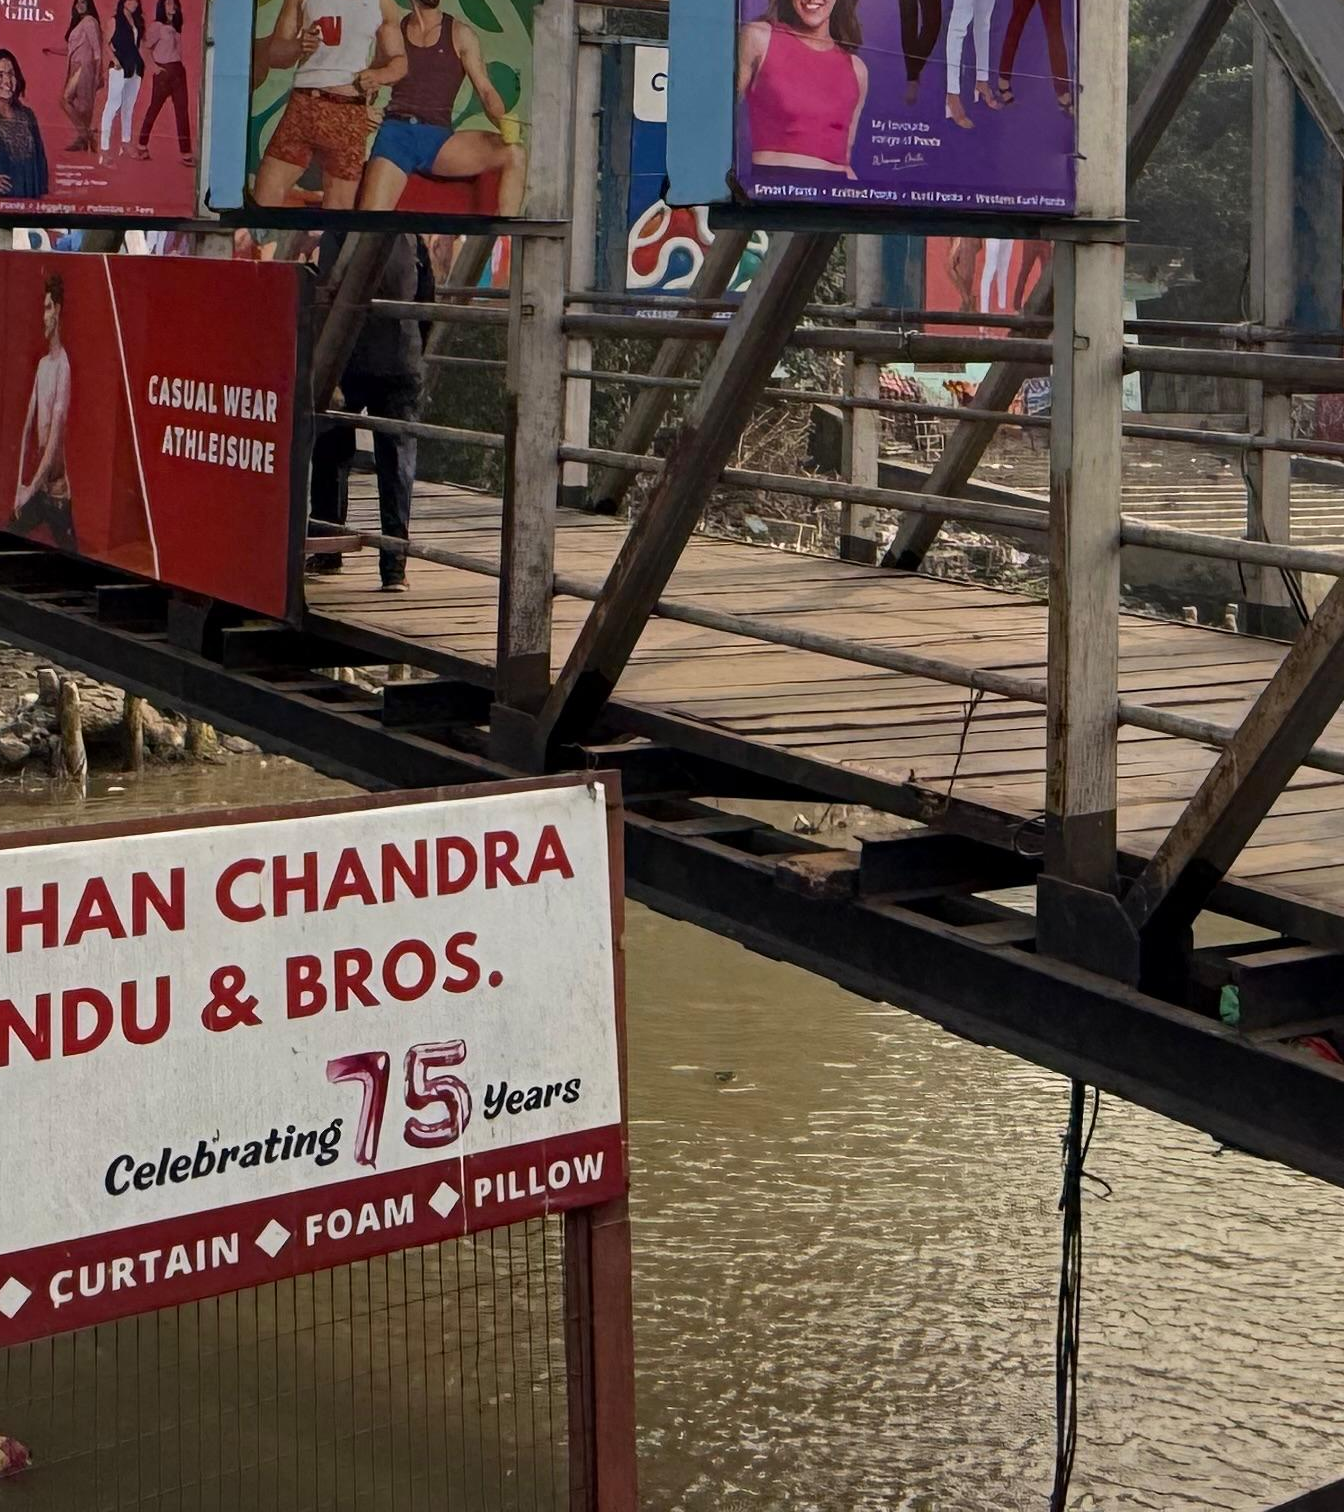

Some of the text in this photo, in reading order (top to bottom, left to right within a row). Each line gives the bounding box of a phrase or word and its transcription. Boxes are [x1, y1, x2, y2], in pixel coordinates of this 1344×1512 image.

[148, 374, 278, 423] CASUAL WEAR
[161, 425, 276, 474] ATHLEISURE
[215, 824, 575, 924] CHANDRA
[201, 963, 263, 1034] &
[285, 930, 504, 1020] BROS.
[103, 1037, 582, 1196] Celebrating 75 Years
[49, 1230, 240, 1308] CURTAIN
[305, 1192, 415, 1247] FOAM
[473, 1150, 606, 1209] PILLOW
